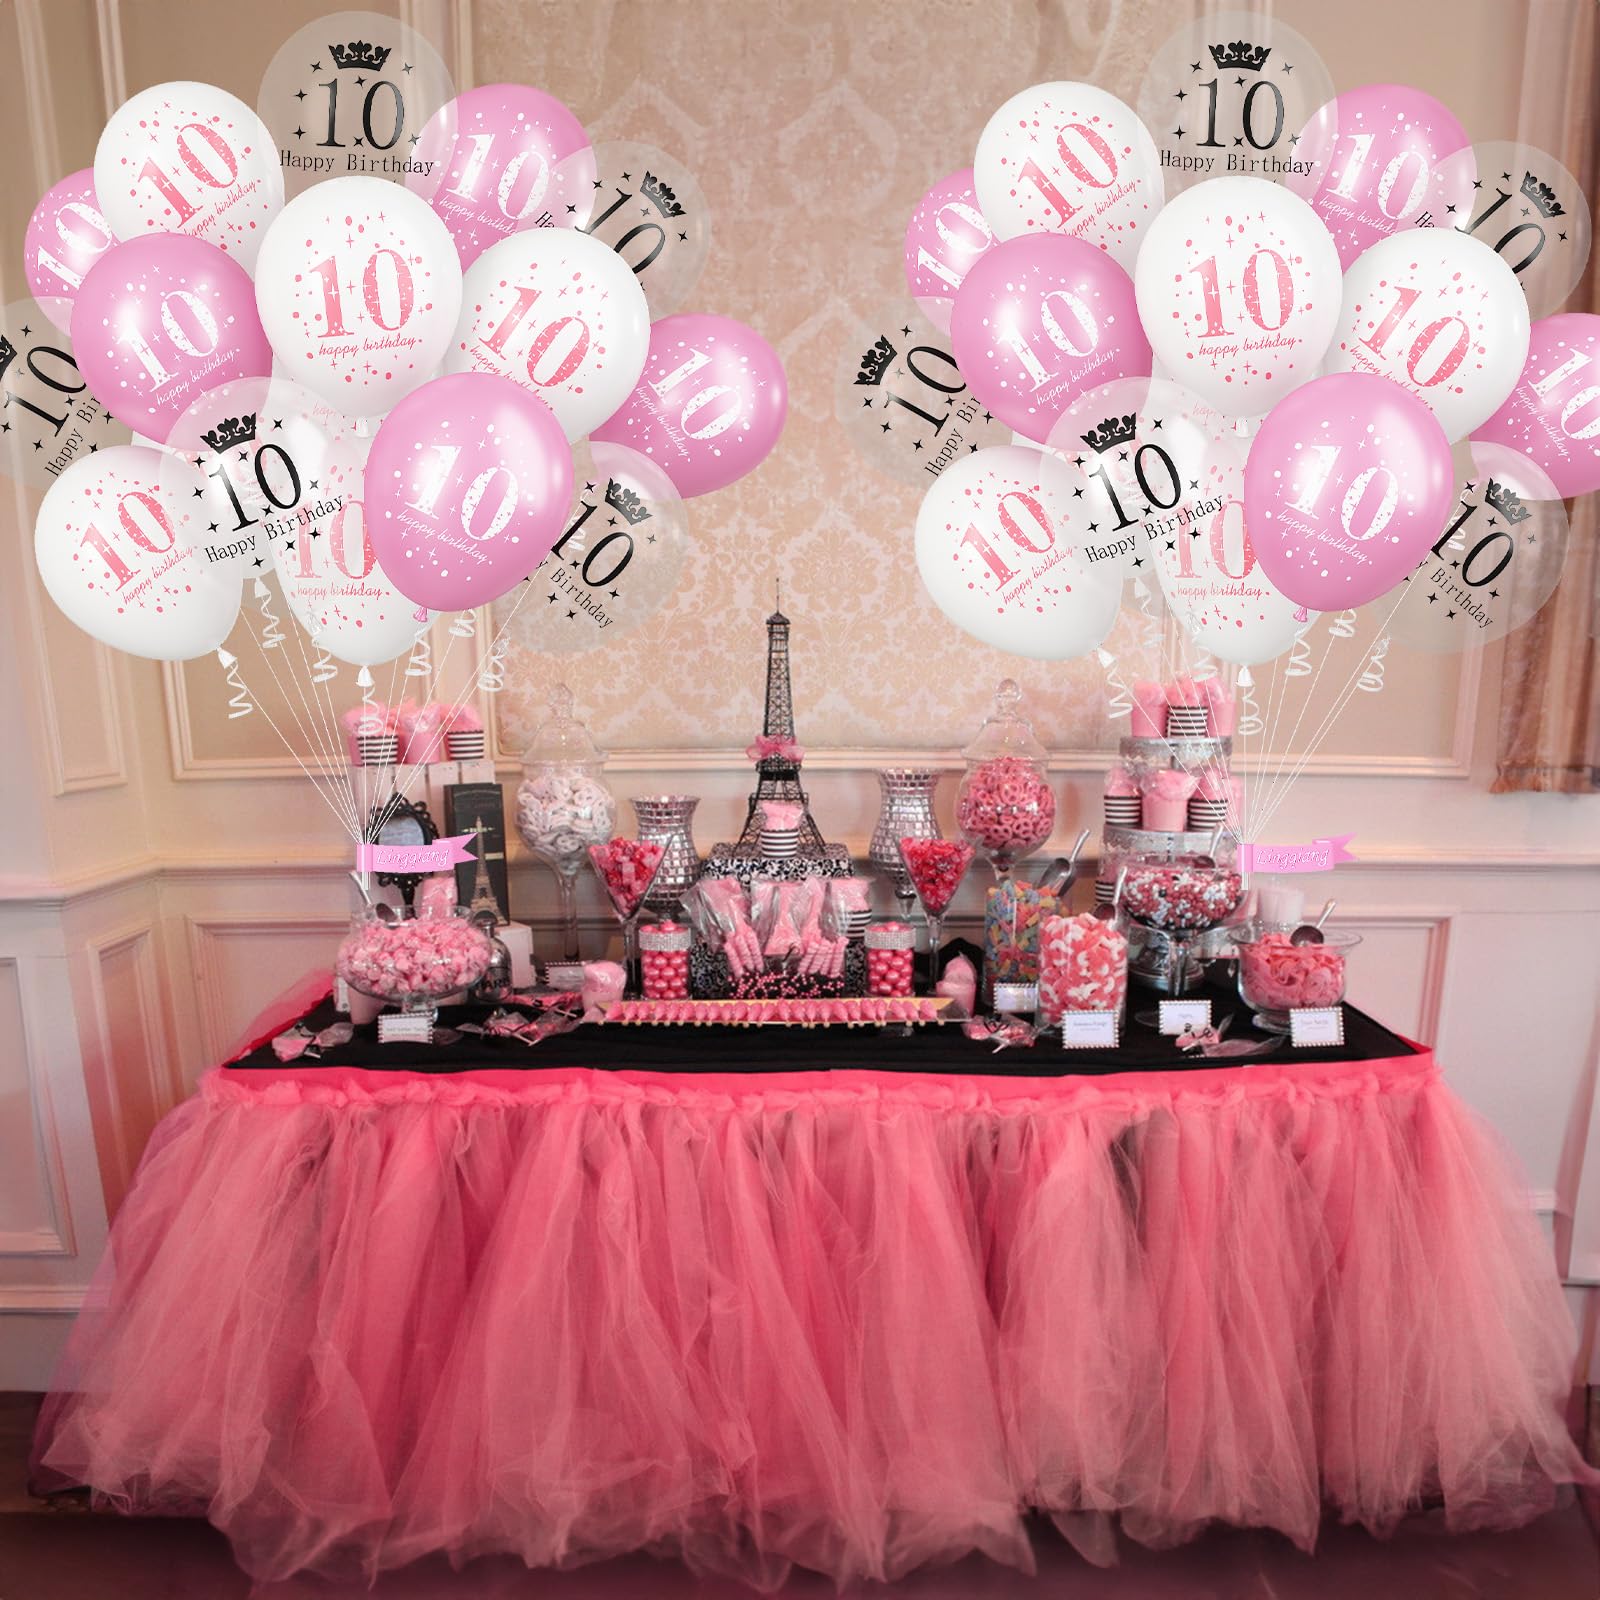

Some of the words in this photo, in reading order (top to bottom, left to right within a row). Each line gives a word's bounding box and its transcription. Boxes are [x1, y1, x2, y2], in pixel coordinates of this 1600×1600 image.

[316, 78, 405, 150] 10
[1196, 78, 1285, 150] 10
[138, 123, 238, 228] 10
[214, 181, 256, 215] birthday
[280, 150, 335, 172] Happy
[347, 154, 434, 176] Birthday
[446, 134, 549, 220] 10
[1018, 123, 1118, 228] 10
[1094, 181, 1136, 215] birthday
[1160, 150, 1215, 172] Happy
[1227, 154, 1314, 176] Birthday
[1326, 134, 1429, 220] 10
[439, 195, 475, 221] happy
[1319, 195, 1355, 221] happy
[38, 202, 112, 290] 10
[918, 202, 992, 290] 10
[309, 249, 414, 338] 10
[1189, 249, 1294, 338] 10
[116, 290, 218, 393] 10
[319, 343, 359, 359] happy
[363, 332, 416, 352] birthday
[478, 286, 590, 388] 10
[996, 290, 1098, 393] 10
[1199, 343, 1239, 359] happy
[1243, 332, 1296, 352] birthday
[1358, 286, 1470, 388] 10
[4, 346, 87, 437] 10
[156, 381, 190, 406] happy
[190, 349, 235, 382] birthday
[647, 348, 743, 440] 10
[884, 346, 967, 437] 10
[1036, 381, 1070, 406] happy
[1070, 349, 1115, 382] birthday
[44, 428, 84, 477] Happy
[635, 386, 661, 416] happy
[657, 414, 690, 457] birthday
[924, 428, 964, 477] Happy
[1515, 386, 1541, 416] happy
[1537, 414, 1570, 457] birthday
[208, 443, 301, 532] 10
[405, 445, 518, 541] 10
[1088, 443, 1181, 532] 10
[1285, 445, 1398, 541] 10
[80, 491, 176, 592] 10
[204, 535, 256, 563] Happy
[264, 494, 343, 541] Birthday
[291, 500, 377, 579] 10
[397, 509, 435, 539] happy
[437, 528, 487, 565] birthday
[551, 500, 634, 587] 10
[960, 491, 1056, 592] 10
[1084, 535, 1136, 563] Happy
[1144, 494, 1223, 541] Birthday
[1171, 500, 1257, 579] 10
[1277, 509, 1315, 539] happy
[1317, 528, 1367, 565] birthday
[1431, 500, 1514, 587] 10
[122, 577, 153, 605] happy
[152, 549, 193, 579] birthday
[297, 582, 328, 601] happy
[330, 582, 383, 601] birthday
[550, 567, 613, 628] Birthday
[1002, 577, 1033, 605] happy
[1032, 549, 1073, 579] birthday
[1177, 582, 1208, 601] happy
[1210, 582, 1263, 601] birthday
[1430, 567, 1493, 628] Birthday
